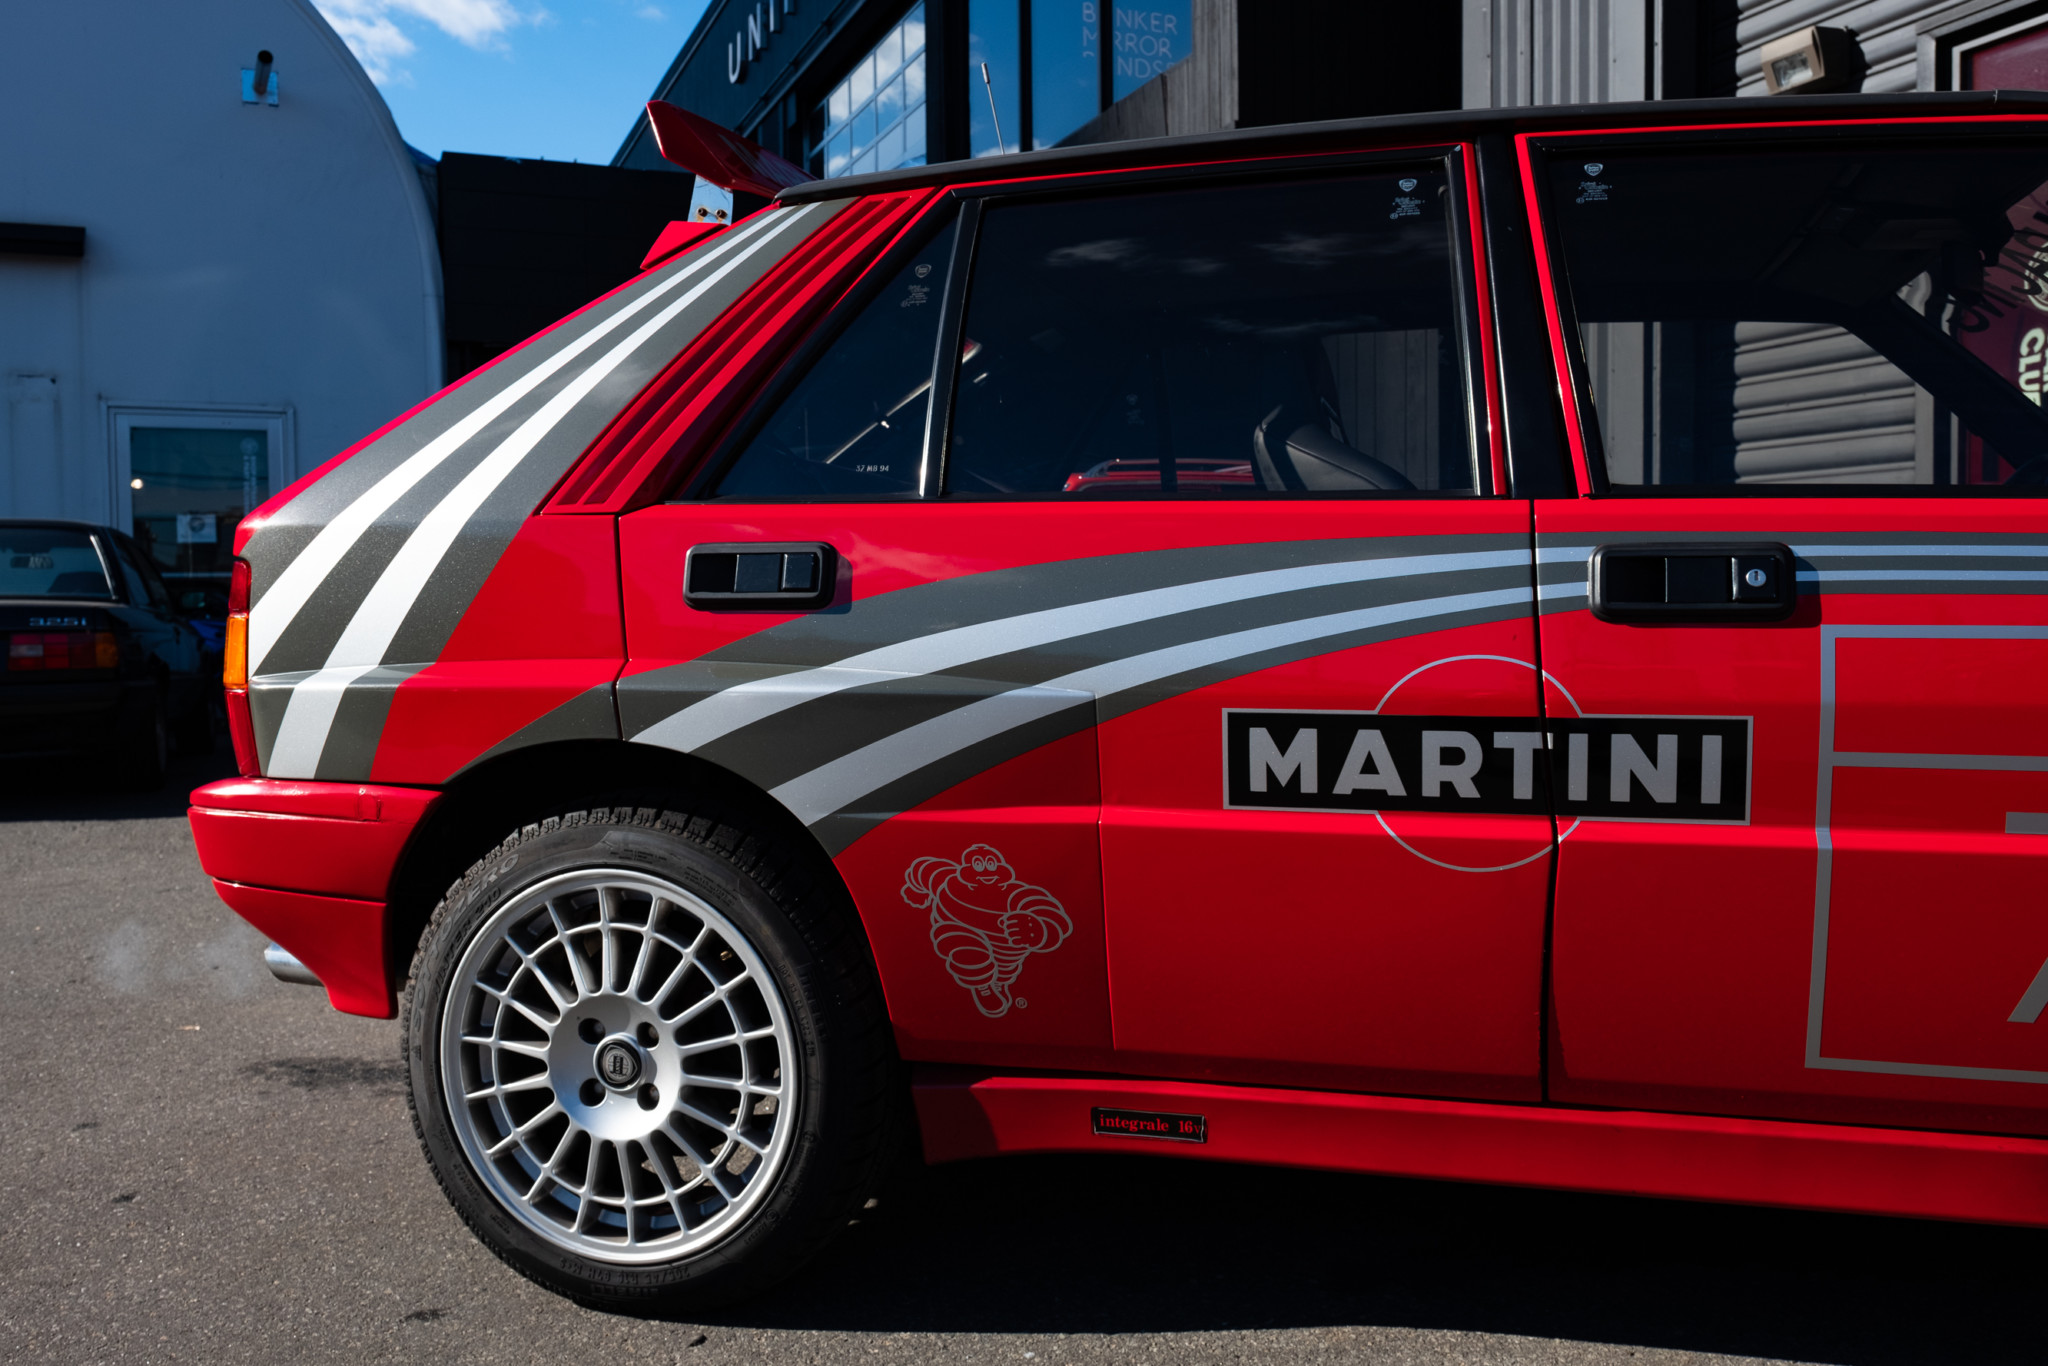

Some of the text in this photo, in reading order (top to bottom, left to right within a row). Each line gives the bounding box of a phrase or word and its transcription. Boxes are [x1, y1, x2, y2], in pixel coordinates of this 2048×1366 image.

[1082, 1, 1178, 35] BNKER
[728, 0, 789, 84] UNI
[1082, 26, 1173, 59] MRROR
[1248, 726, 1723, 806] MARTINI
[1100, 1114, 1169, 1132] integrale
